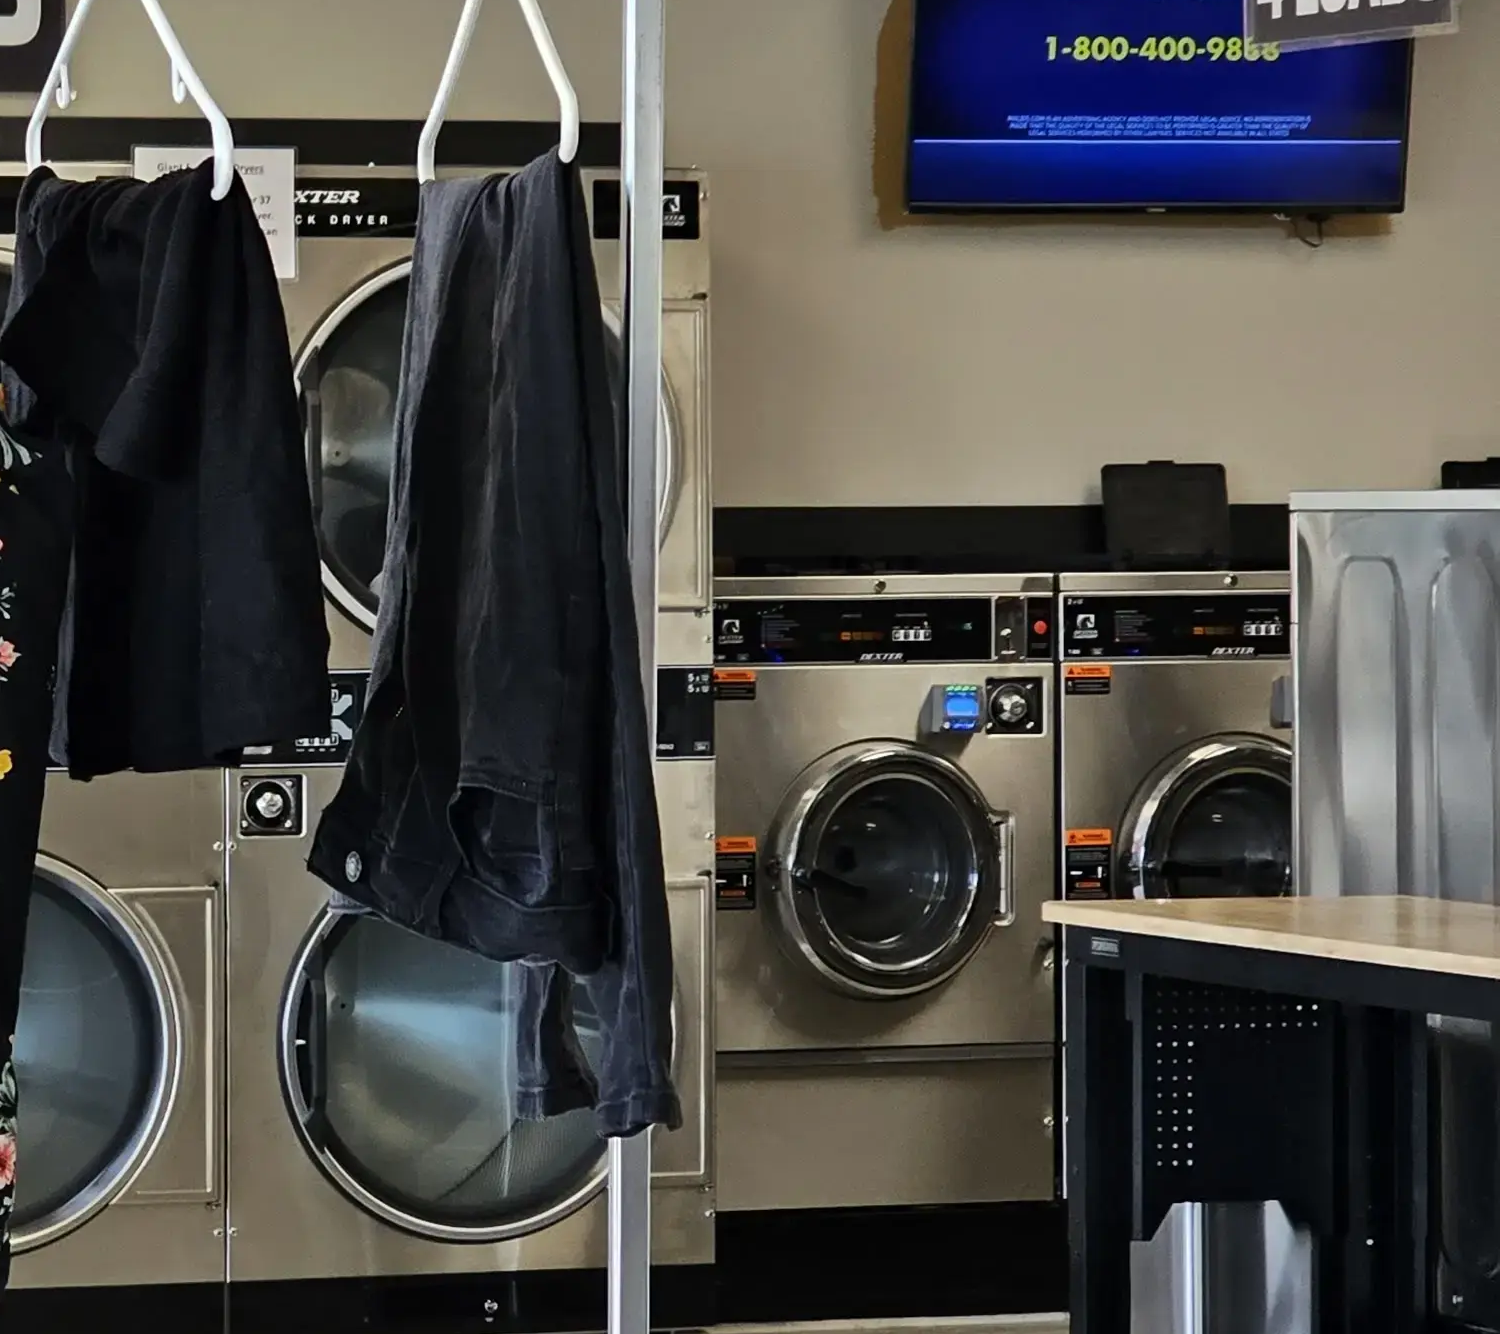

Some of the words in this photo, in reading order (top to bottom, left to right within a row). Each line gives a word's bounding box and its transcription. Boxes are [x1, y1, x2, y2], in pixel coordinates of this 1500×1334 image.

[294, 190, 360, 204] XTER
[330, 215, 388, 224] DRYER
[1212, 647, 1255, 656] DEXTER
[860, 652, 904, 661] DEXTER
